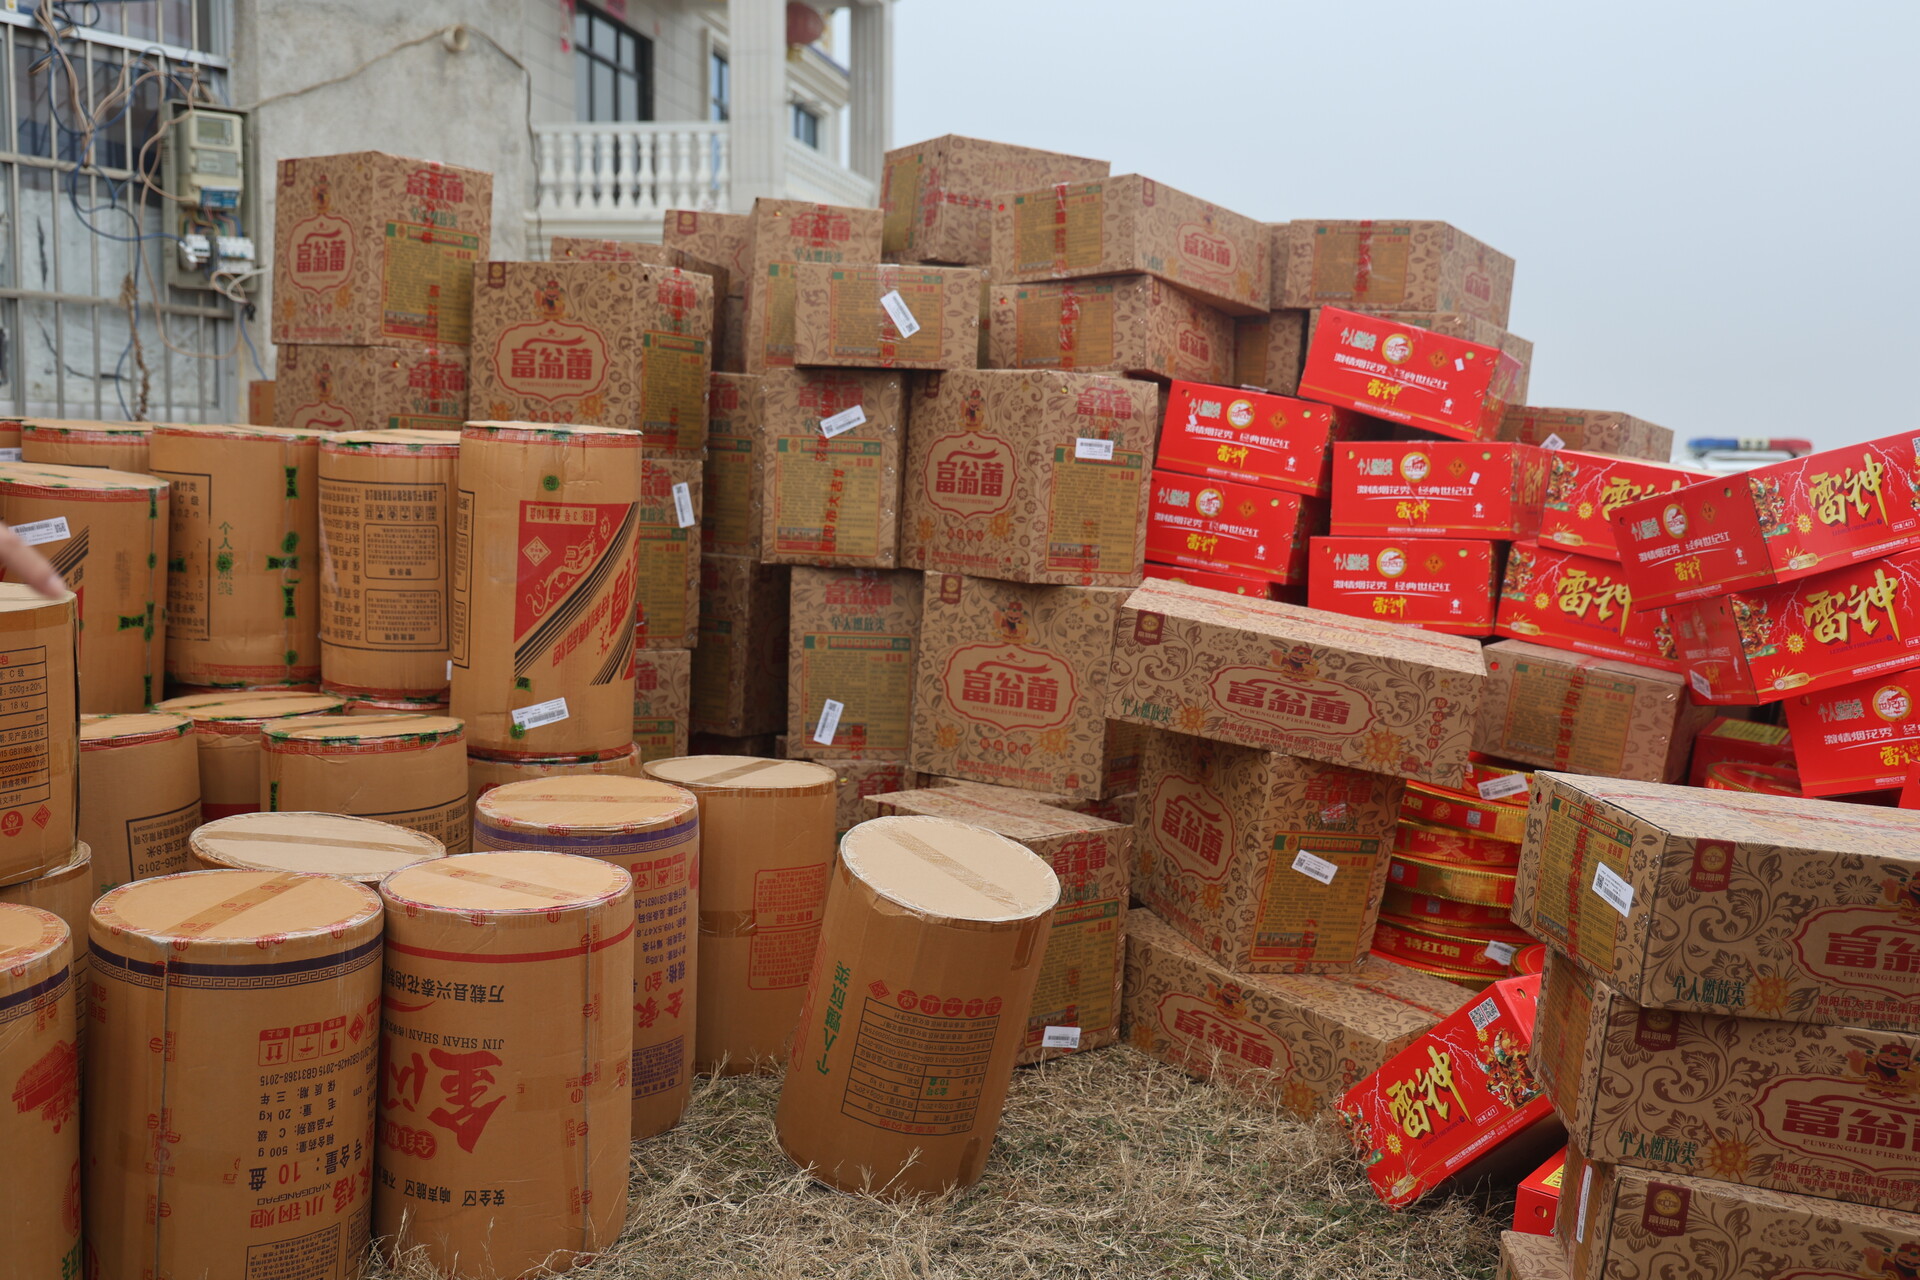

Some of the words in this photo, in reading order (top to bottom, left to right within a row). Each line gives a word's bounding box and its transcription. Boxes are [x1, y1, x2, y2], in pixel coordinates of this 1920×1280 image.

[296, 227, 346, 273] 富翁蕾
[511, 336, 594, 381] 富翁蕾
[1367, 378, 1402, 406] 雷神
[1217, 444, 1249, 469] 雷神
[935, 449, 1006, 497] 富翁蕾
[1809, 453, 1889, 528] 雷神
[1395, 499, 1431, 523] 雷神
[1186, 533, 1219, 555] 雷神
[1674, 555, 1703, 582] 雷神
[1372, 595, 1407, 619] 雷神
[1557, 568, 1633, 637] 雷神
[1803, 568, 1901, 645] 雷神
[830, 616, 886, 632] 个人燃放类
[962, 661, 1059, 712] 富翁蕾
[1121, 697, 1172, 723] 个人燃放类
[1226, 679, 1351, 725] 富翁蕾
[1824, 727, 1893, 745] 激情烟花秀
[1161, 794, 1225, 867] 富翁蕾
[1404, 936, 1460, 958] 特红炮
[1844, 971, 1905, 983] FUWENGLEI
[1673, 975, 1745, 1007] 个人燃放类
[816, 960, 851, 1076] 个人燃放类
[409, 1028, 439, 1045] SHAN
[442, 1035, 478, 1048] SHAN
[482, 1038, 504, 1050] JIN
[1174, 1008, 1274, 1069] 富翁蕾
[1385, 1045, 1473, 1139] 雷神
[259, 1111, 272, 1122] kg
[278, 1109, 291, 1120] 20
[294, 1115, 334, 1135] 产品级别:
[257, 1130, 268, 1140] 级
[279, 1128, 286, 1138] C
[258, 1148, 264, 1157] g
[270, 1146, 288, 1157] 500
[1619, 1129, 1699, 1166] 个人燃放类
[1802, 1138, 1873, 1157] FUWENGLEI
[249, 1167, 267, 1191] 盘
[279, 1161, 301, 1184] 10
[257, 1182, 331, 1206] XIAOGANGPAO
[480, 1189, 505, 1207] 安全
[250, 1195, 324, 1229] 小钢炮
